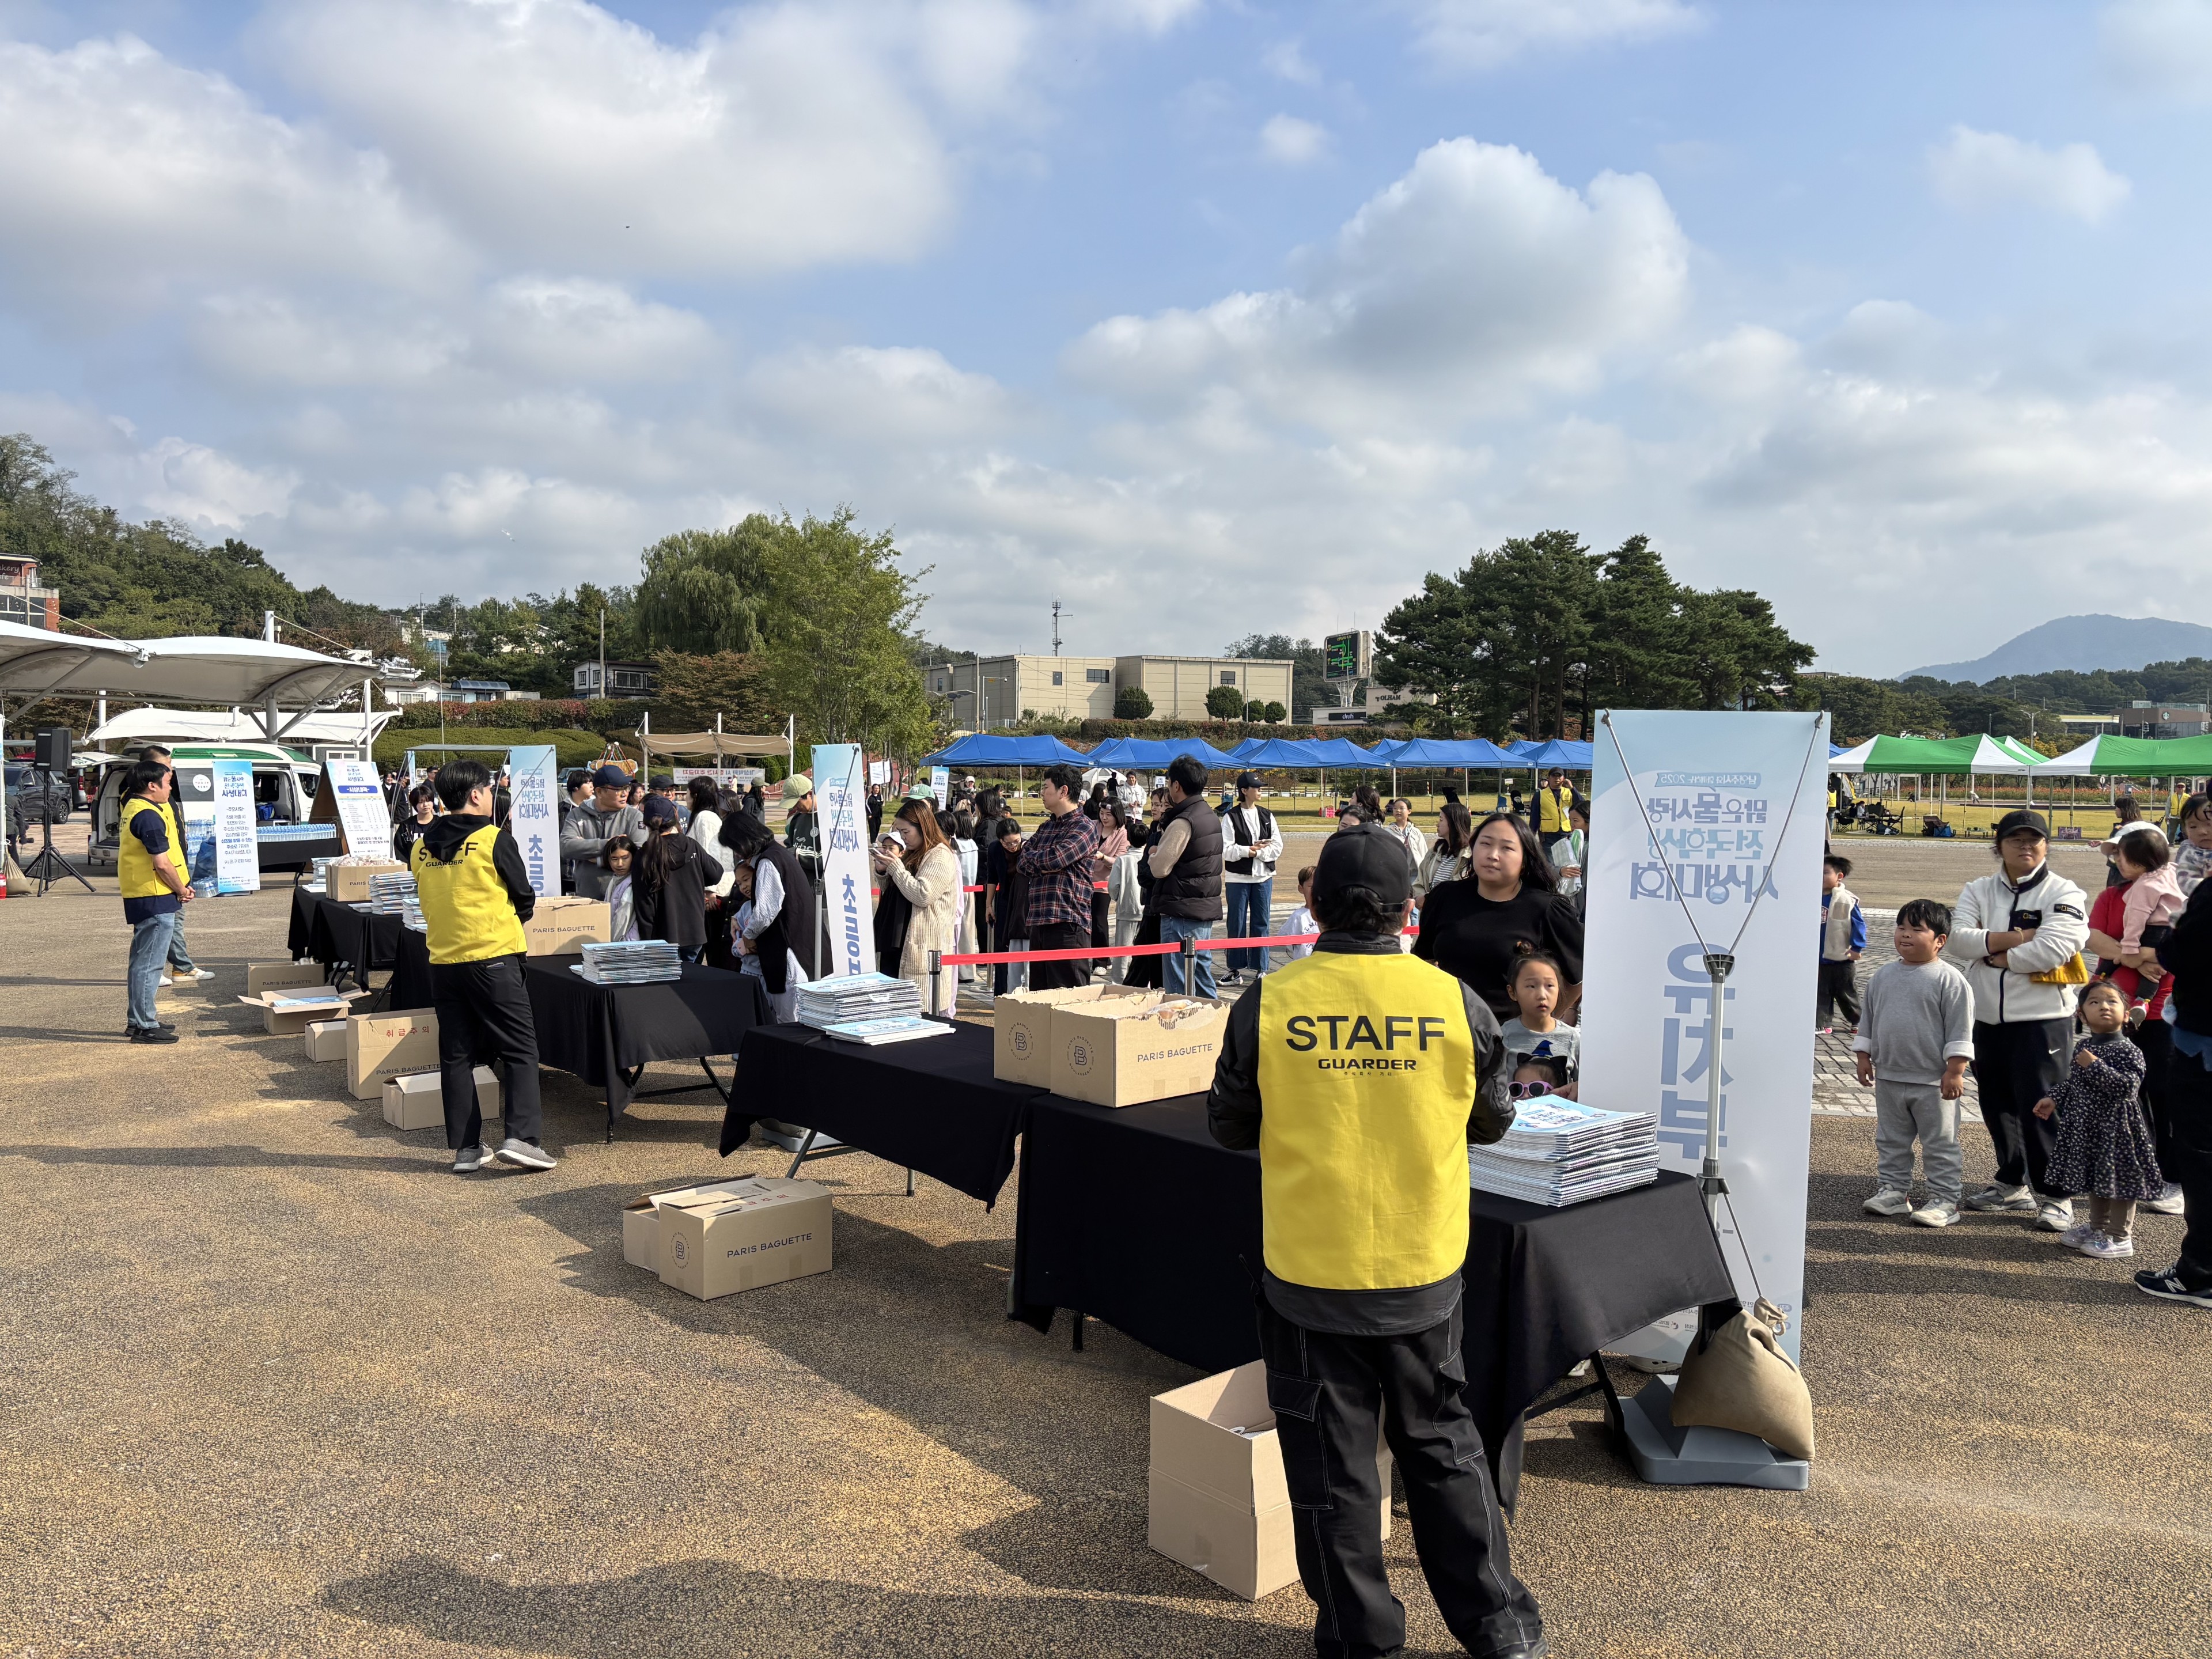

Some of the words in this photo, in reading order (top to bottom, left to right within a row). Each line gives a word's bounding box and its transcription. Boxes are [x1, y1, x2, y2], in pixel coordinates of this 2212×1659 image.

[0, 564, 19, 573] kery
[386, 1025, 429, 1037] 취급주의
[1286, 1016, 1445, 1051] STAFF
[1138, 1051, 1164, 1063] PARIS
[1168, 1043, 1213, 1058] BAGUETTE
[402, 1064, 441, 1073] BAGUETTE
[1318, 1059, 1416, 1070] GUARDER
[727, 1245, 757, 1258] PARIS
[760, 1233, 812, 1251] BAGUETTE
